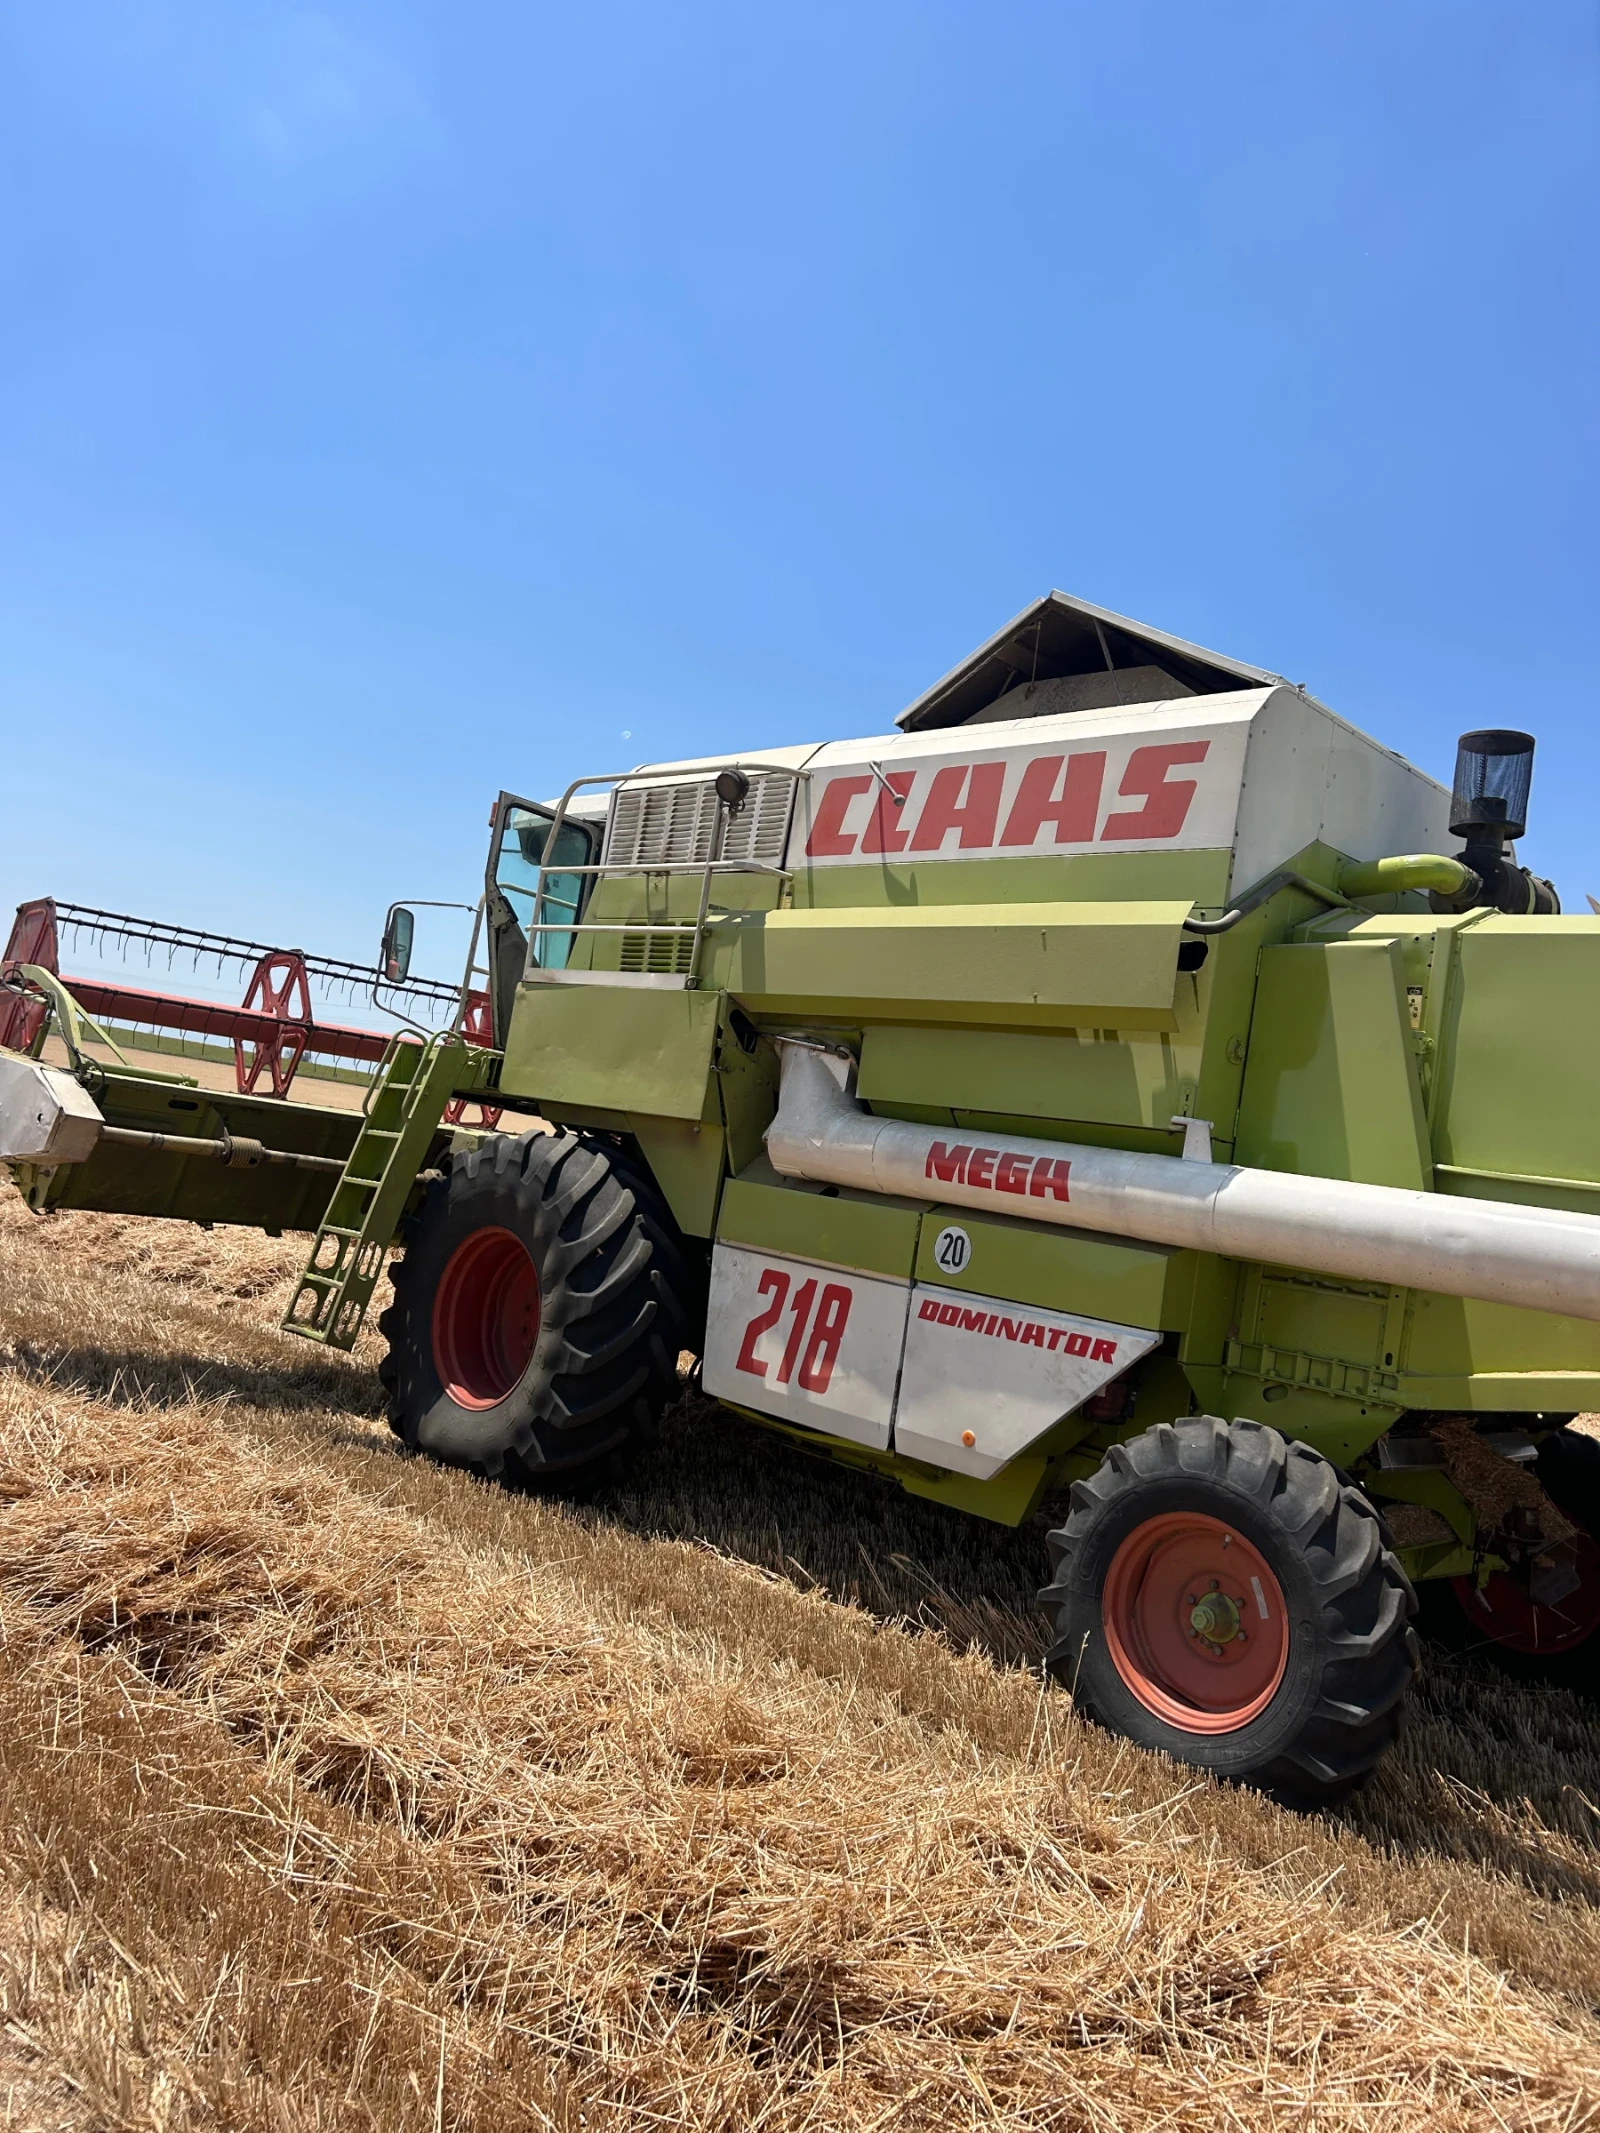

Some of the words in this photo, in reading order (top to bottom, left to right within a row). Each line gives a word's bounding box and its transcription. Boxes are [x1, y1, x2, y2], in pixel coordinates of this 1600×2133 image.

[804, 740, 1210, 857] CLAAS
[925, 1141, 1071, 1202] MEGA
[940, 1232, 965, 1267] 20
[736, 1268, 853, 1395] 218
[918, 1300, 1117, 1364] DOMINATOR
